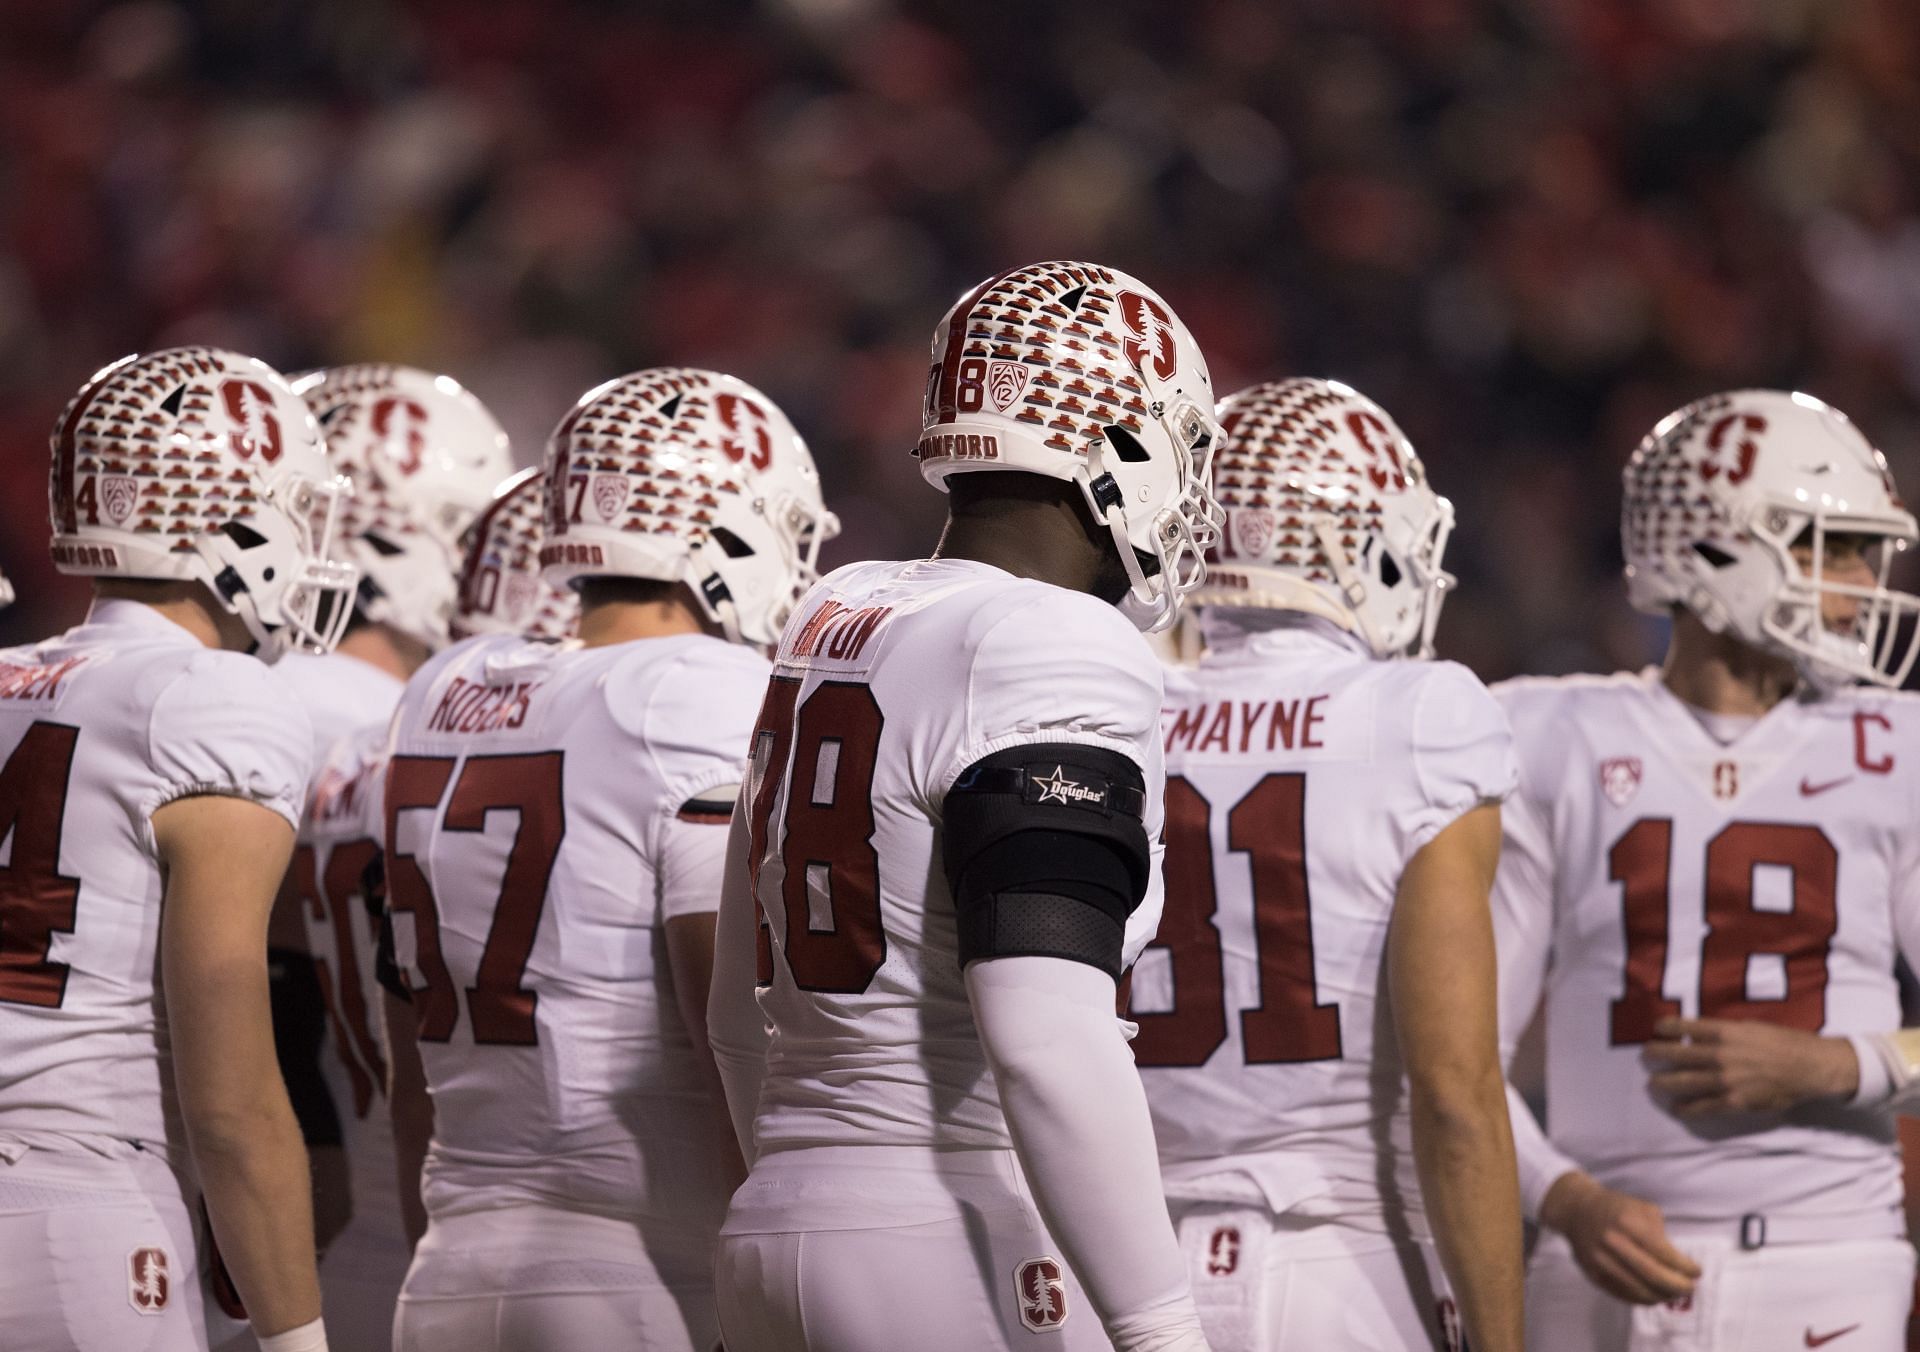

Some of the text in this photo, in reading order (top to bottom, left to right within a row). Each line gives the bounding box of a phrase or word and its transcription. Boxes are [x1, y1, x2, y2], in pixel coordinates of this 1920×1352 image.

[992, 364, 1026, 392] PAC
[997, 387, 1013, 402] 12
[76, 475, 100, 526] 4
[569, 474, 589, 525] 7
[1161, 694, 1330, 753] MAYNE
[1853, 712, 1894, 775] C
[0, 719, 81, 1009] 4
[386, 750, 566, 1047] 57
[1609, 816, 1839, 1048] 18
